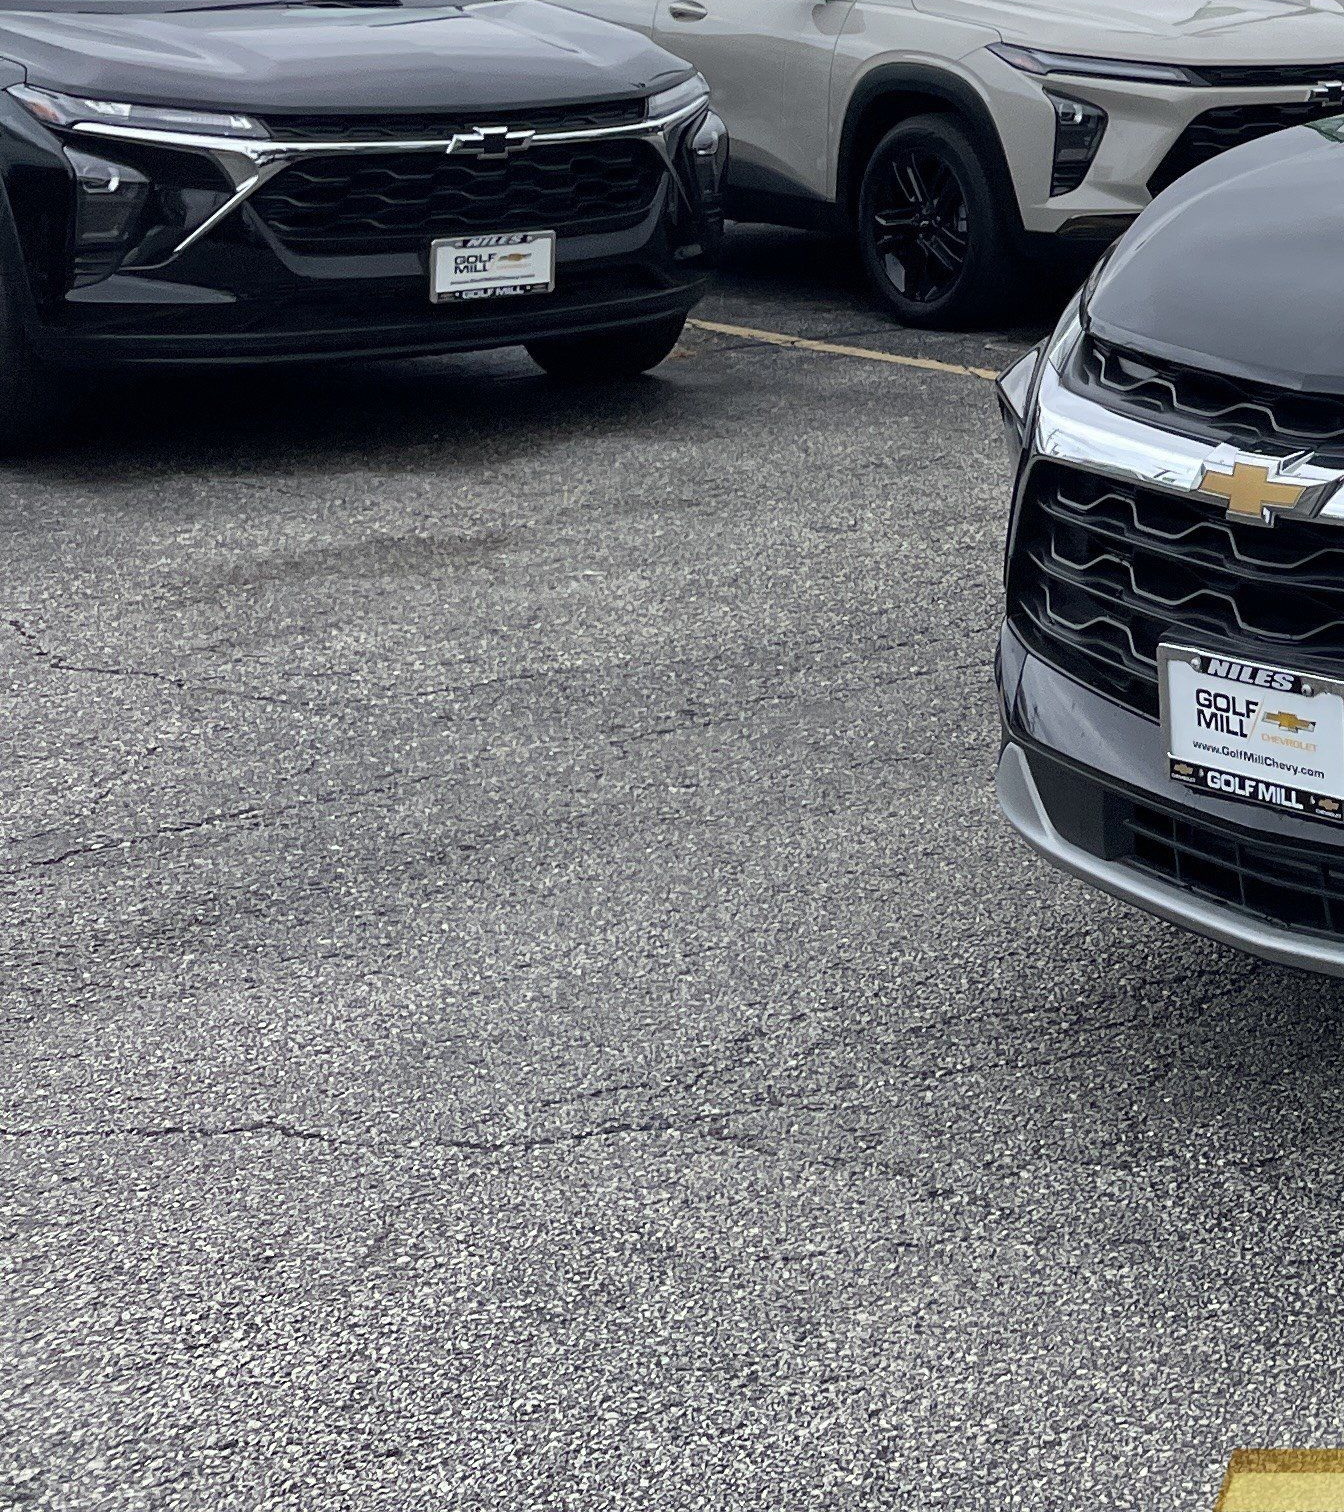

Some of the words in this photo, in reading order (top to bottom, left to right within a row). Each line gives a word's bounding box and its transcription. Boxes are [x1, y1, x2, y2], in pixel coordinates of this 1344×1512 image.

[454, 252, 498, 266] GOLF
[454, 262, 489, 275] MILL
[1207, 658, 1296, 692] NILES
[1195, 688, 1259, 719] GOLF
[1196, 707, 1249, 739] MILL
[1260, 732, 1318, 753] CHEVROLET
[1192, 740, 1326, 780] www.GolfMillChevy.com
[1206, 770, 1256, 797] GOLF
[1257, 782, 1304, 811] MILL
